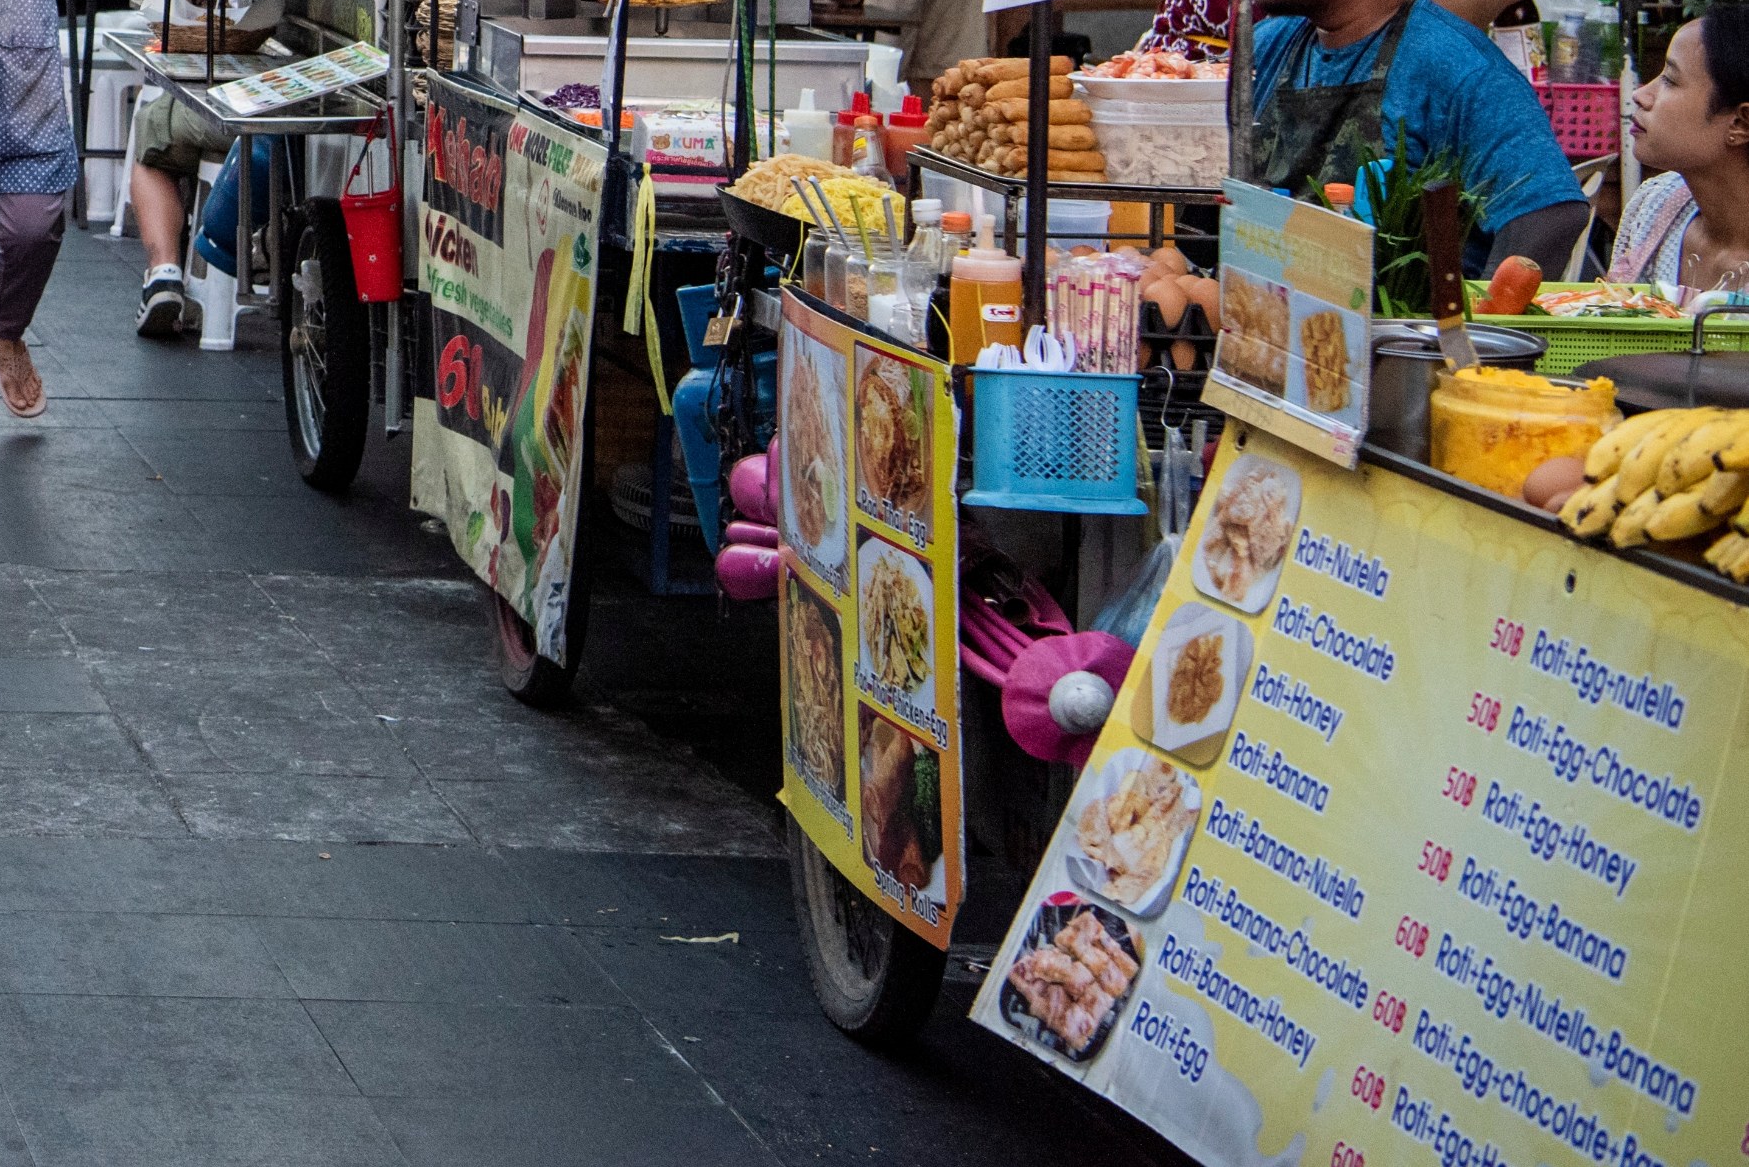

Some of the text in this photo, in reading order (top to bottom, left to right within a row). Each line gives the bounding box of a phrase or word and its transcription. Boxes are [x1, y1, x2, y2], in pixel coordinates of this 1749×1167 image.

[672, 137, 715, 151] KUMA
[425, 211, 479, 279] icken
[1295, 526, 1390, 600] Roti+Nutella
[1272, 595, 1395, 682] Roti+Chocolate
[1530, 629, 1685, 729] Roti+Egg+nutella
[1251, 664, 1345, 744] Roti+Honey
[1228, 731, 1329, 815] Roti+Banana
[1505, 703, 1702, 832] Roti+Egg+Chocolate
[1205, 799, 1365, 920] Roti+Banana+Nutella
[1482, 778, 1637, 898] Roti+Egg+Honey
[873, 858, 939, 928] Spring Rolls
[1182, 867, 1368, 1010] Roti+Banana+Chocolate
[1458, 856, 1627, 980] Roti+Egg+Banana
[1129, 999, 1210, 1083] Roti+Egg
[1156, 932, 1315, 1070] Roti+Banana+Honey
[1436, 932, 1696, 1116] Roti+Egg+Nutella+Banana
